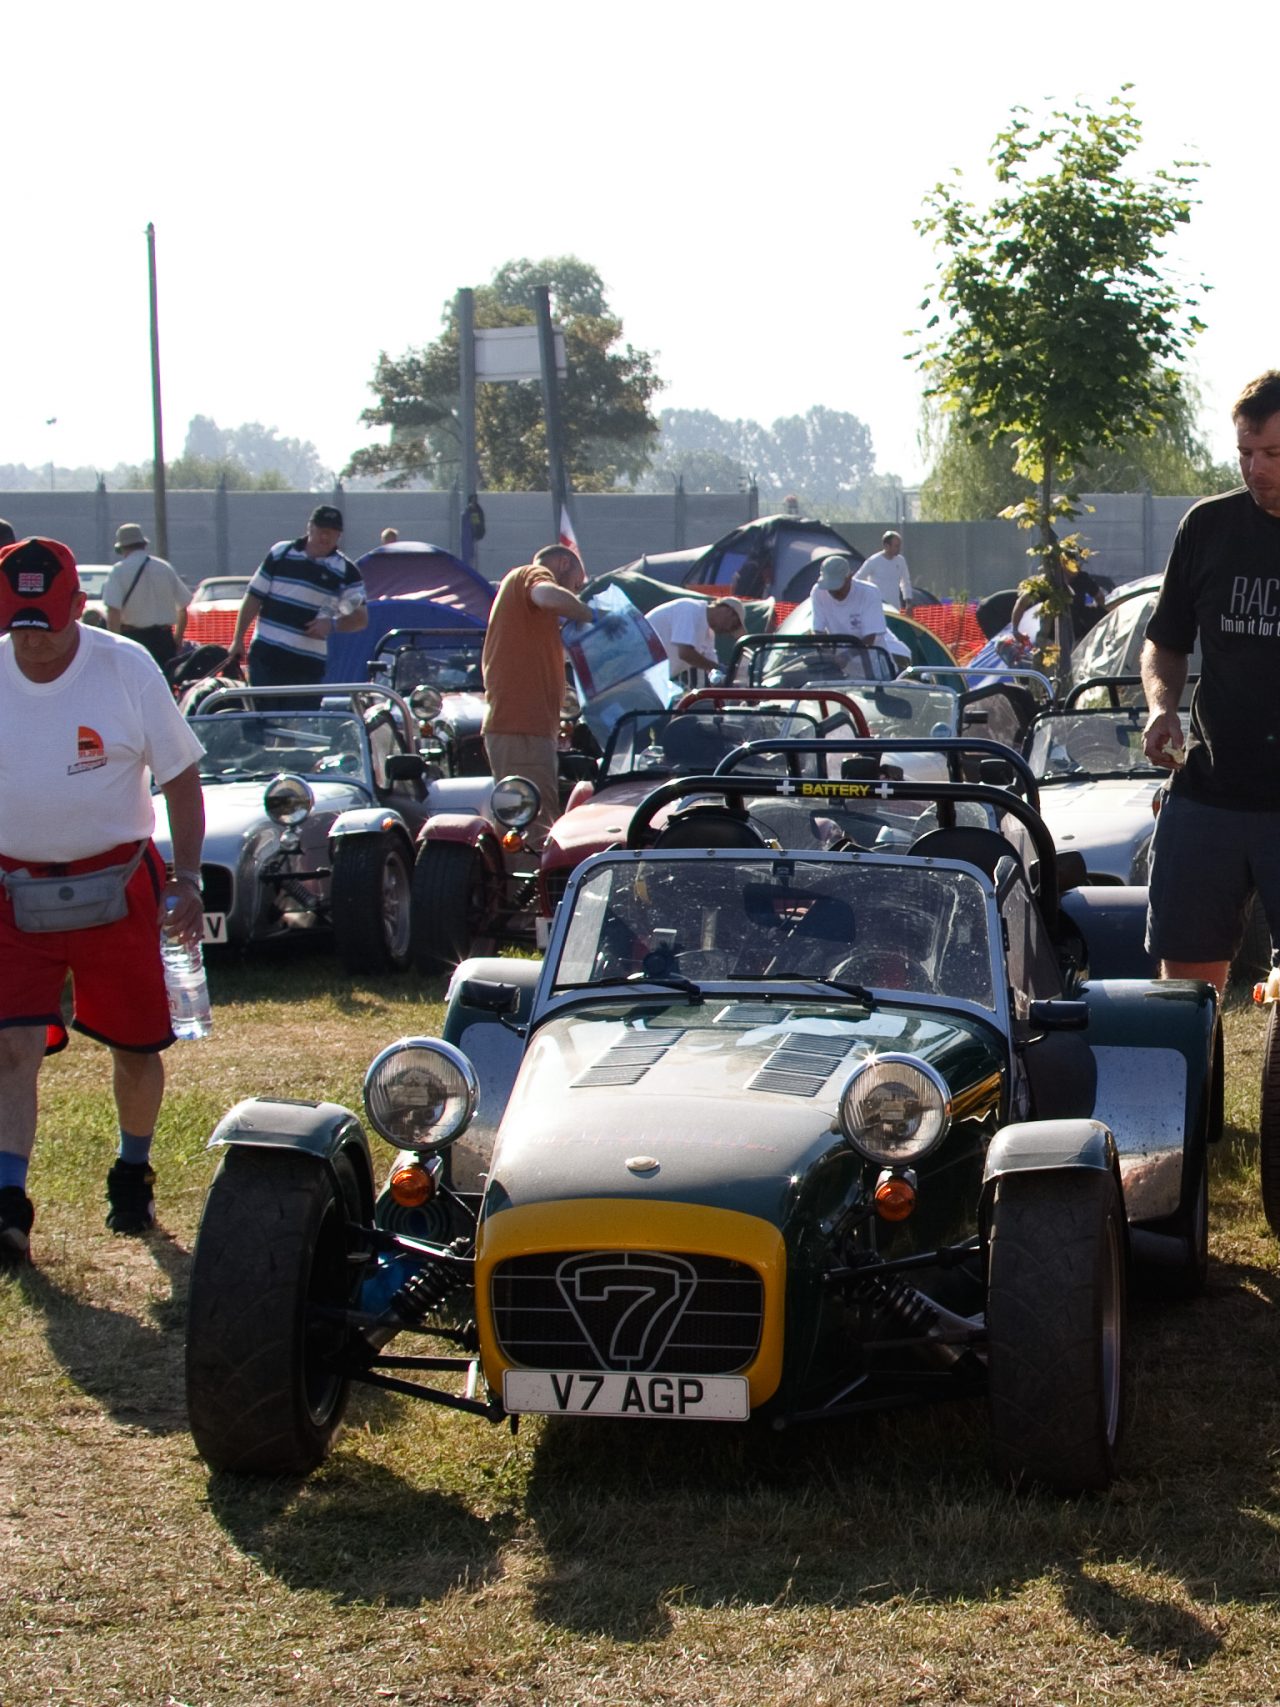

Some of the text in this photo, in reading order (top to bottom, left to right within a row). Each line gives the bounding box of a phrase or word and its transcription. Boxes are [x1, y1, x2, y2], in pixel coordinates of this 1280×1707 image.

[1235, 616, 1245, 634] in
[1247, 616, 1256, 635] it
[1258, 617, 1274, 636] for
[802, 783, 870, 797] BATTERY
[575, 1264, 680, 1361] 7
[551, 1373, 703, 1414] V7 AGP
